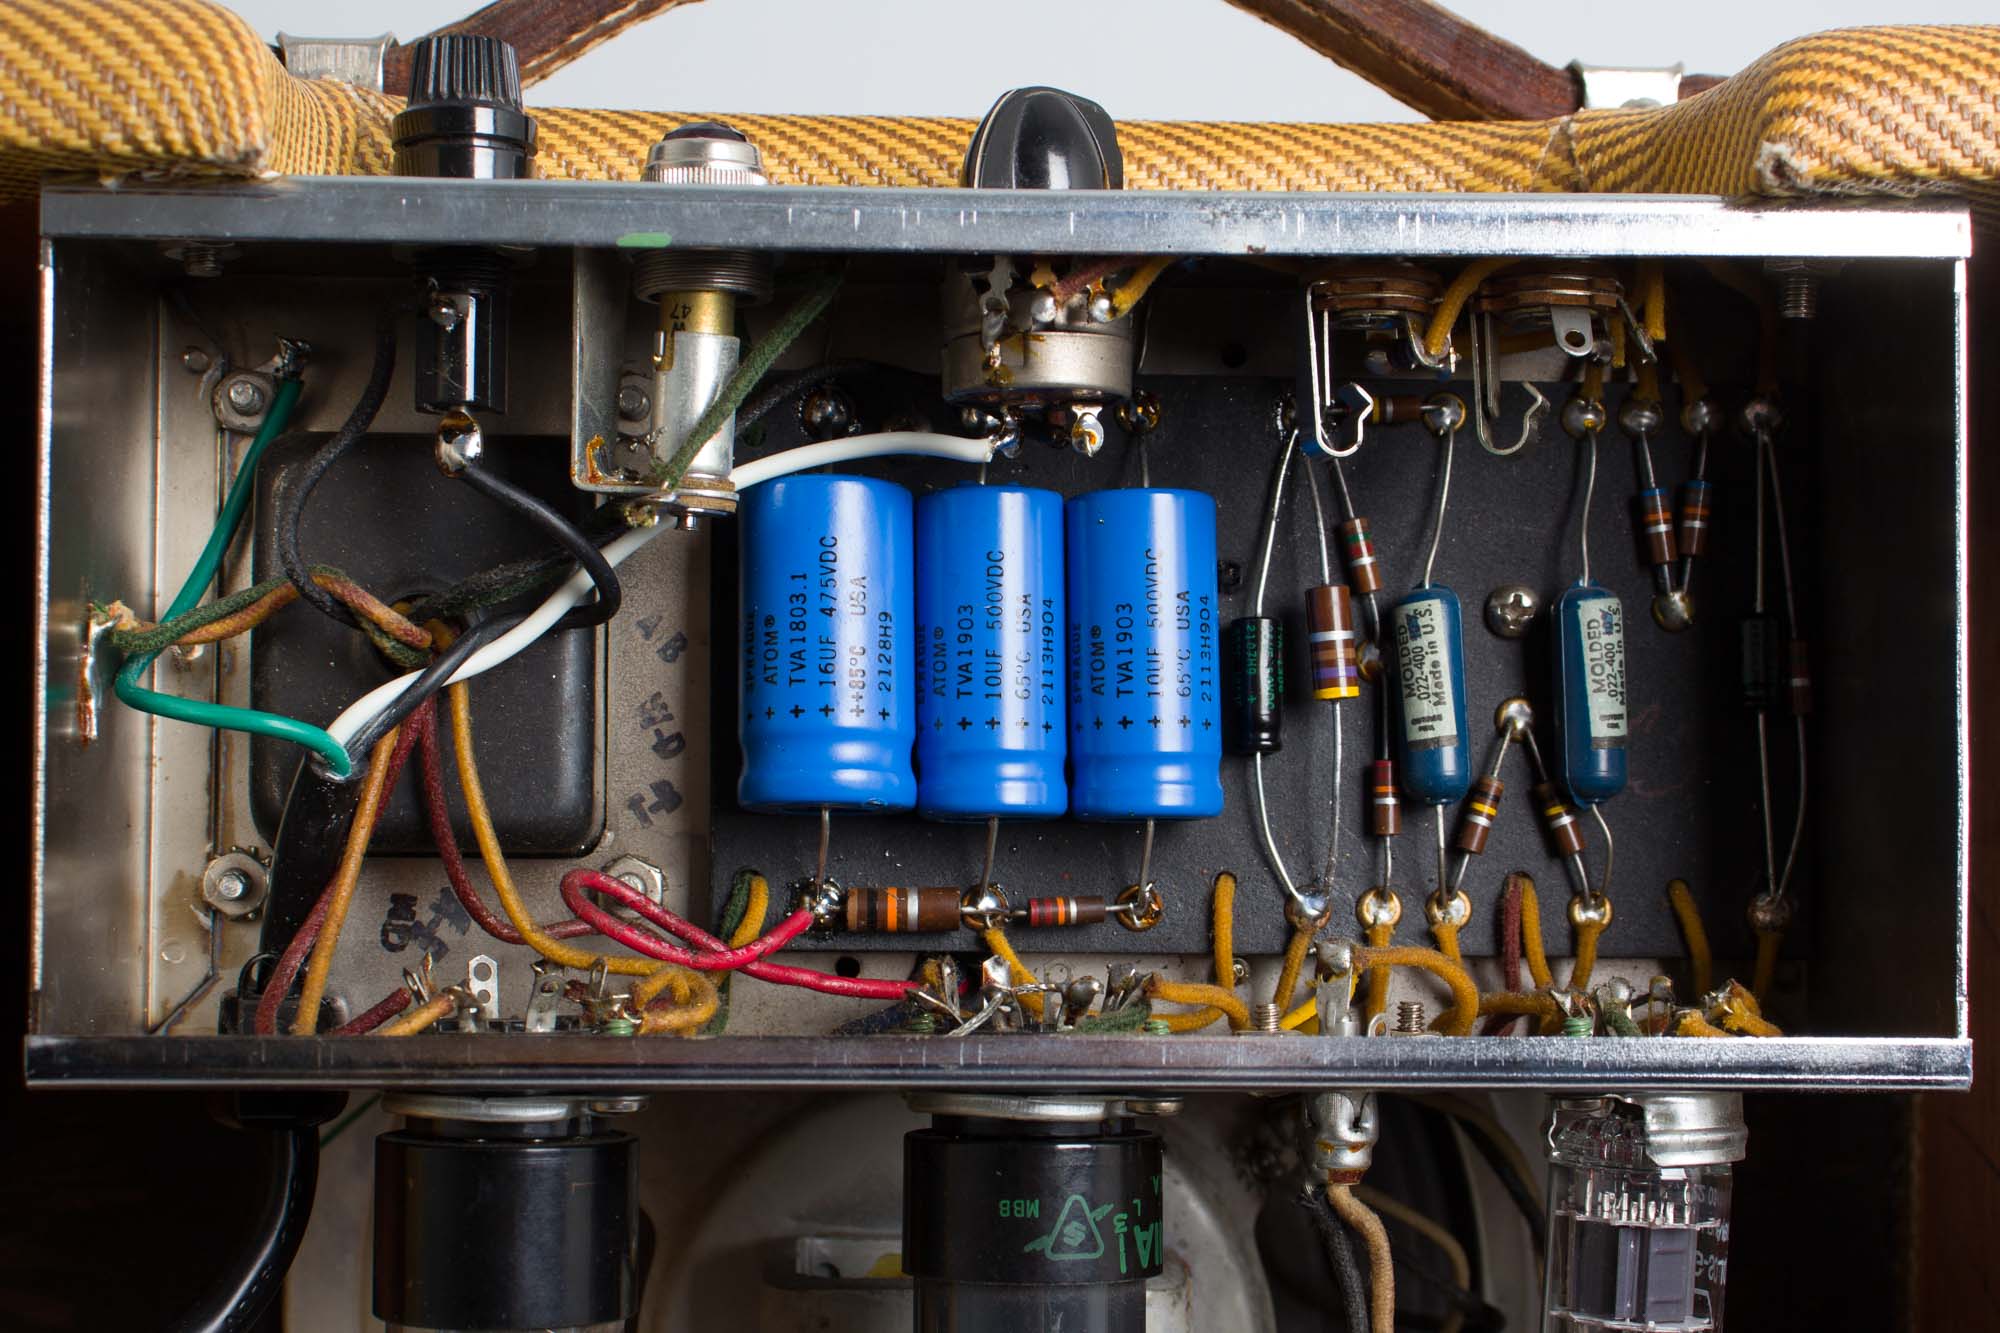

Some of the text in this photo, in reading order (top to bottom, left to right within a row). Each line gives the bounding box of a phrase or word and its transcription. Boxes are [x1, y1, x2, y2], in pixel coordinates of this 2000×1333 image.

[820, 536, 838, 617] 475VDC
[850, 576, 866, 616] USA
[987, 551, 1004, 630] 500VDC
[1146, 549, 1163, 628] 500VDC
[790, 573, 807, 687] TVA1803.1
[1016, 594, 1031, 633] USA
[1177, 591, 1190, 630] USA
[764, 616, 778, 685] ATOM®
[819, 636, 837, 687] 16UF
[878, 612, 892, 692] 2128H9
[933, 627, 947, 696] ATOM®
[957, 605, 973, 699] TVA1903
[985, 650, 1002, 700] 10UF
[1015, 652, 1031, 700] 65°C
[1042, 598, 1054, 704] 2113H904
[1091, 625, 1105, 695] ATOM®
[1117, 603, 1134, 698] TVA1903
[1147, 648, 1163, 697] 10UF
[1176, 649, 1191, 697] 65°C
[1200, 594, 1212, 702] 2113H904
[1398, 625, 1417, 699] MOLDED
[1412, 646, 1432, 703] .022-400
[1426, 641, 1438, 655] in
[1587, 619, 1607, 693] MOLDED
[1605, 643, 1618, 702] .022-400
[1616, 641, 1622, 653] in
[1430, 661, 1447, 706] Made
[1616, 661, 1626, 705] Made
